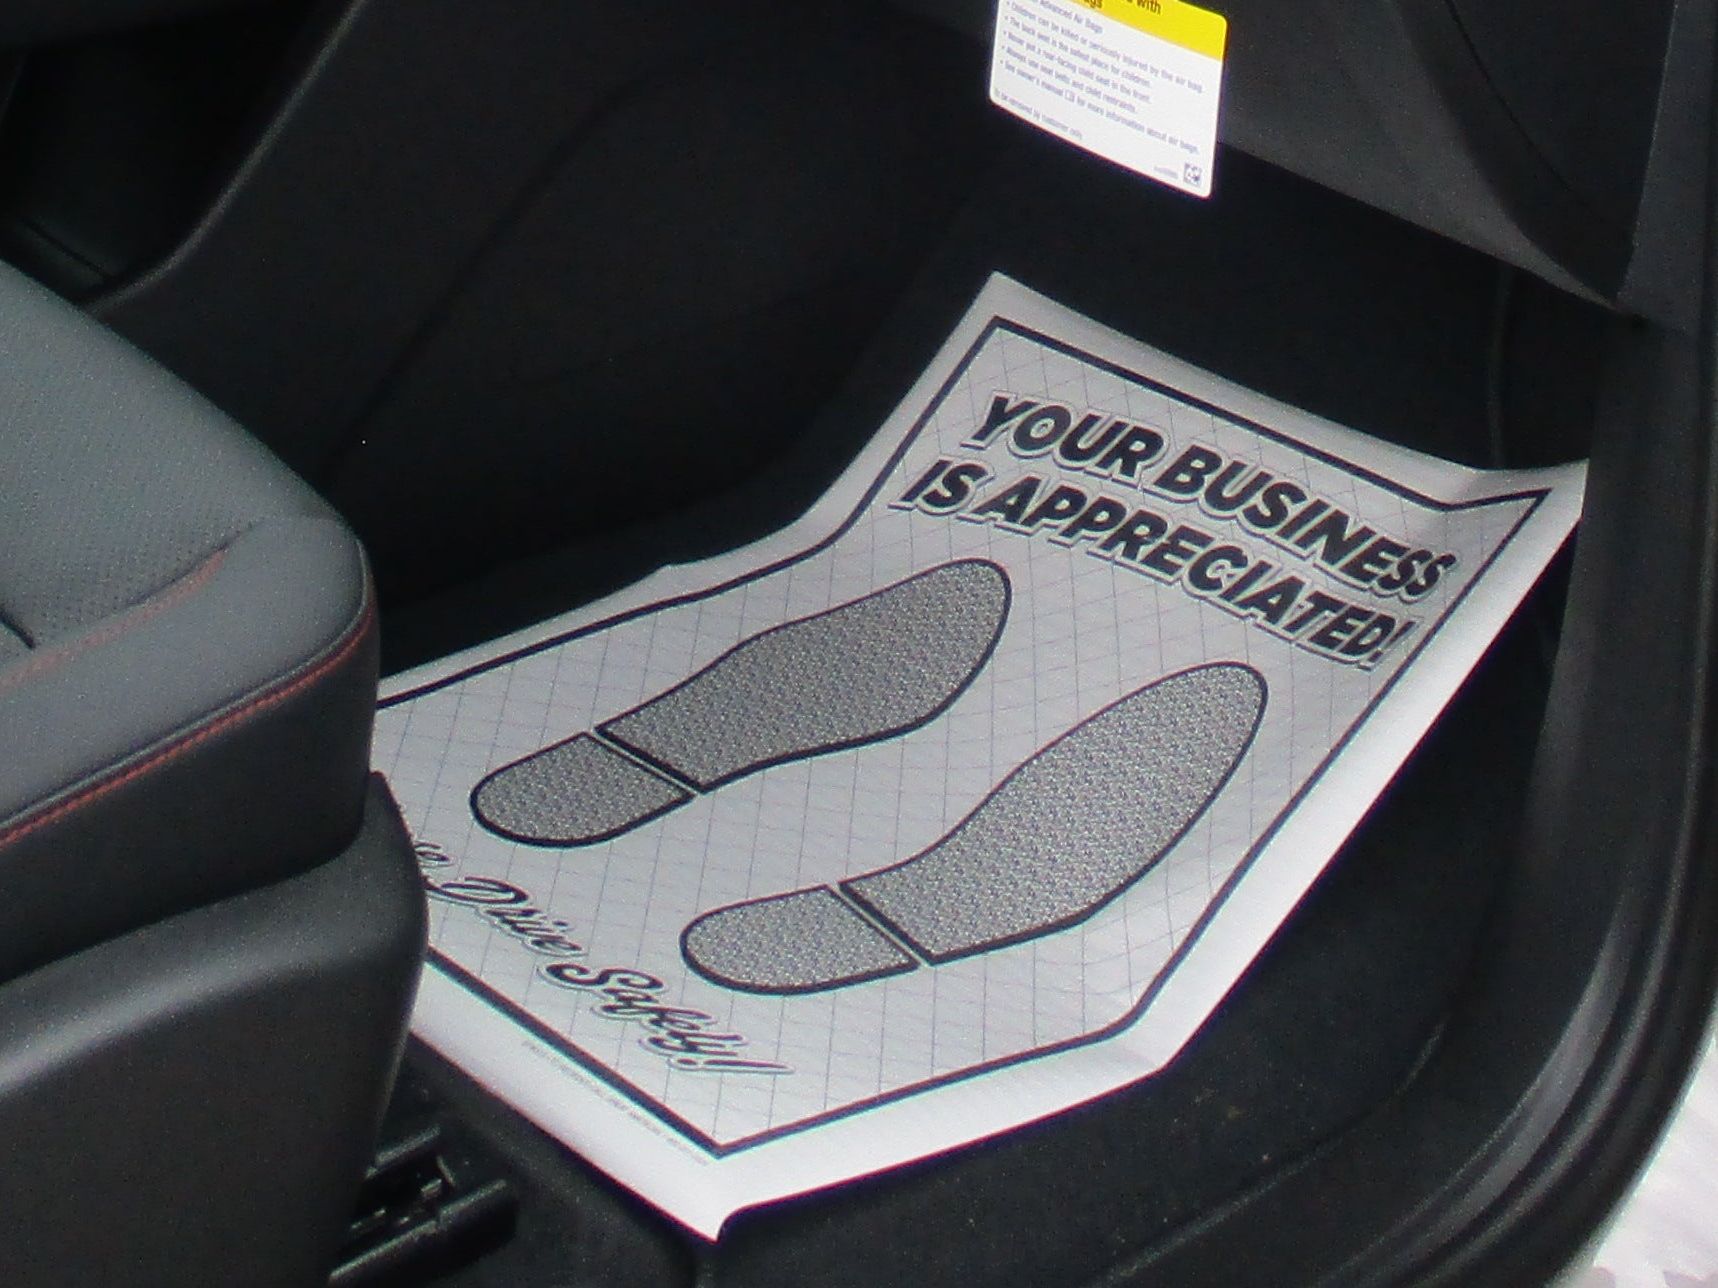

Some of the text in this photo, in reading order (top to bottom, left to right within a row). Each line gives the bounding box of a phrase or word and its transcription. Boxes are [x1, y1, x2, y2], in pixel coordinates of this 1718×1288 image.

[902, 459, 1419, 666] IS APPRECIATED!
[969, 394, 1458, 599] YOUR BUSINESS
[426, 875, 791, 1071] Drive Safely!
